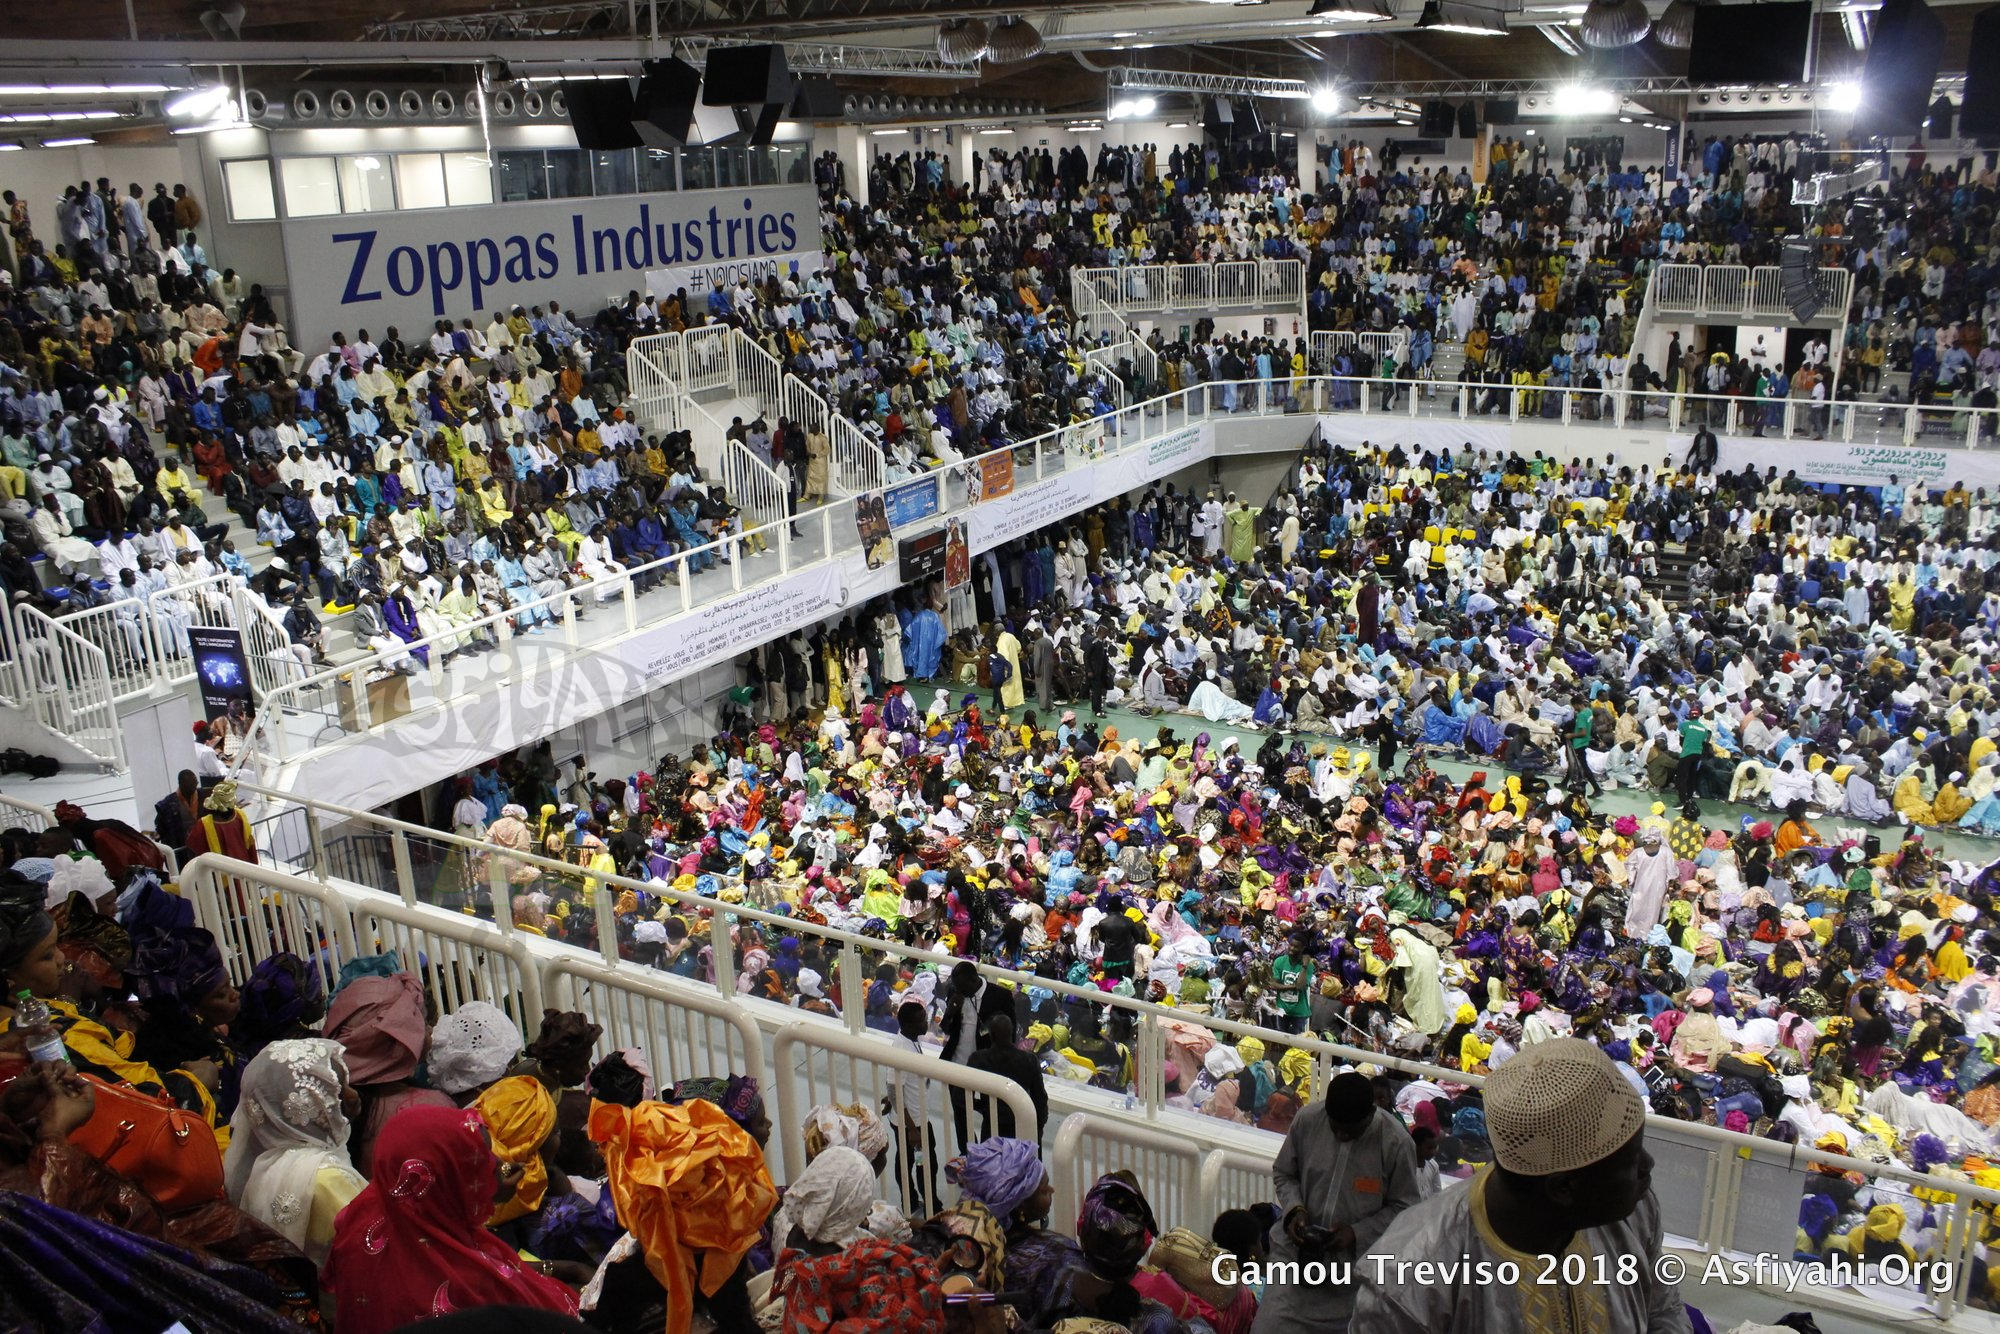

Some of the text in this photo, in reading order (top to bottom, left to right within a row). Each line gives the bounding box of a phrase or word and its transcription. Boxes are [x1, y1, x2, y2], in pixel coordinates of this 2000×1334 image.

[333, 198, 797, 315] Zoppas Industries
[690, 260, 779, 292] #NOICISIAMO
[760, 622, 771, 632] VOUS
[696, 641, 705, 650] MES
[708, 631, 727, 645] HOMMES
